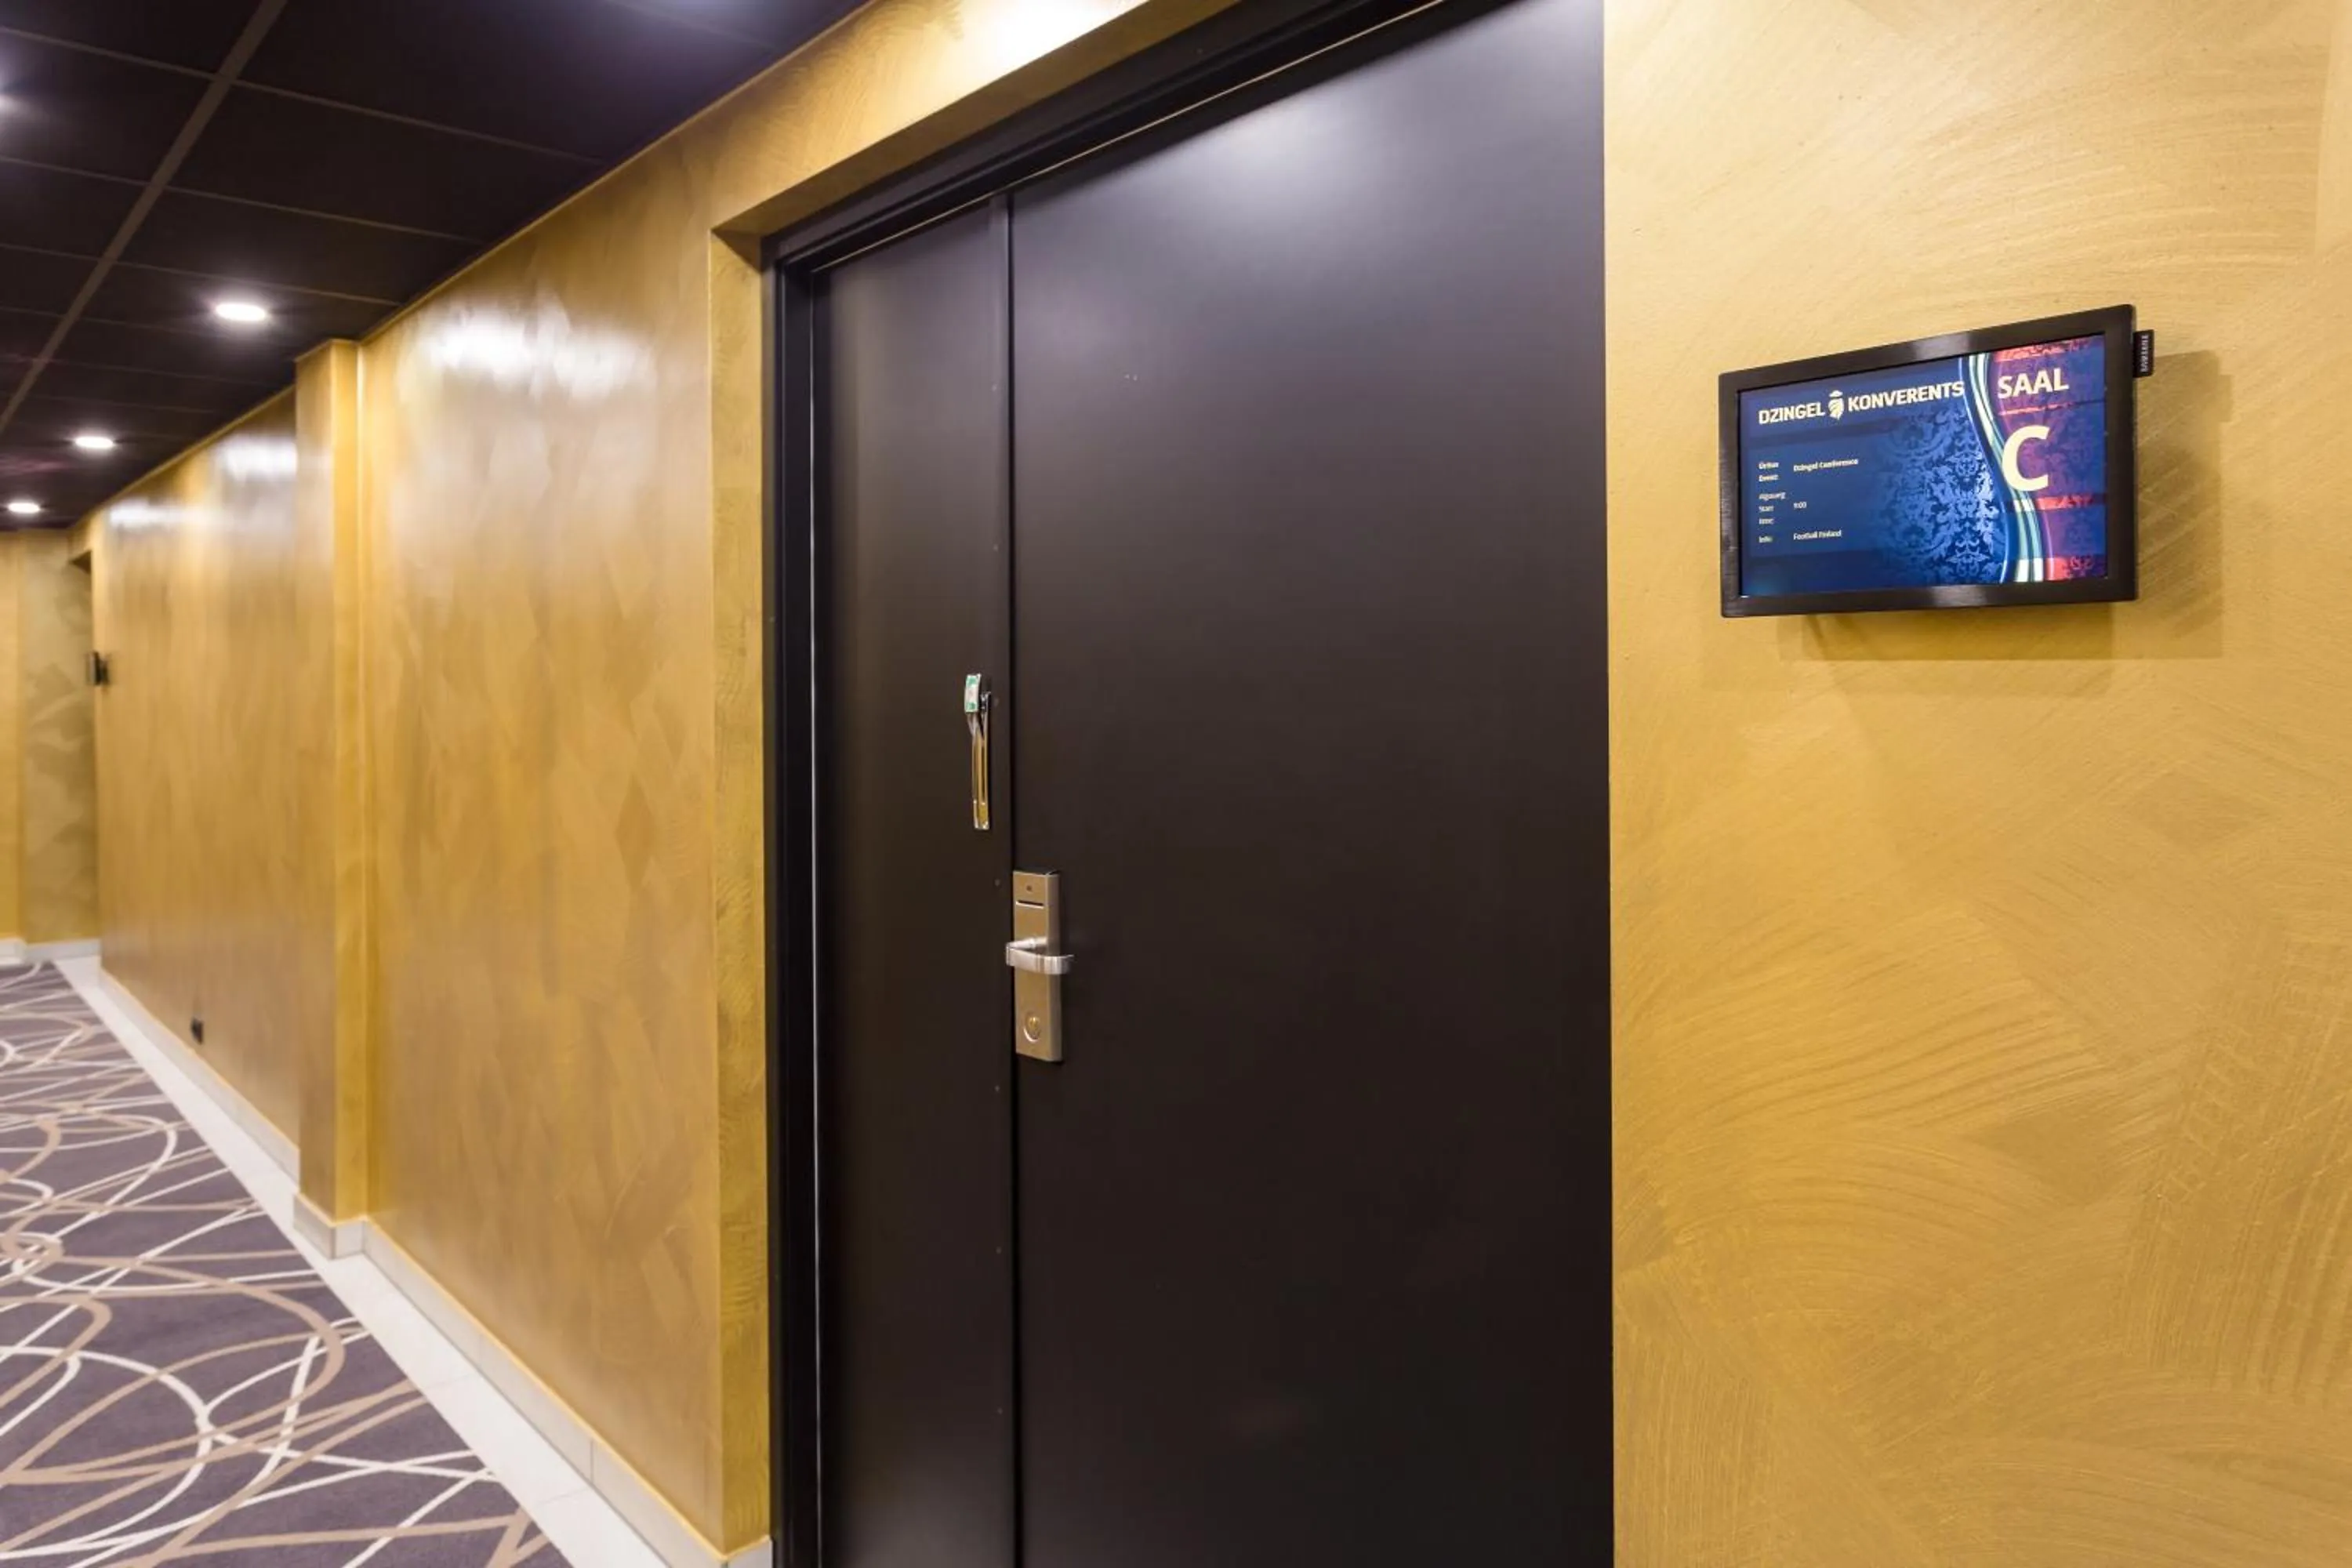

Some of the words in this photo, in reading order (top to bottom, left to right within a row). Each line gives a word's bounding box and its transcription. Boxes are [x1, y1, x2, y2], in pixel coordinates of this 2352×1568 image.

[1759, 401, 1825, 424] DZINGEL
[1848, 380, 1965, 412] KONVERENTS
[1998, 368, 2070, 399] SAAL
[2002, 424, 2050, 492] C
